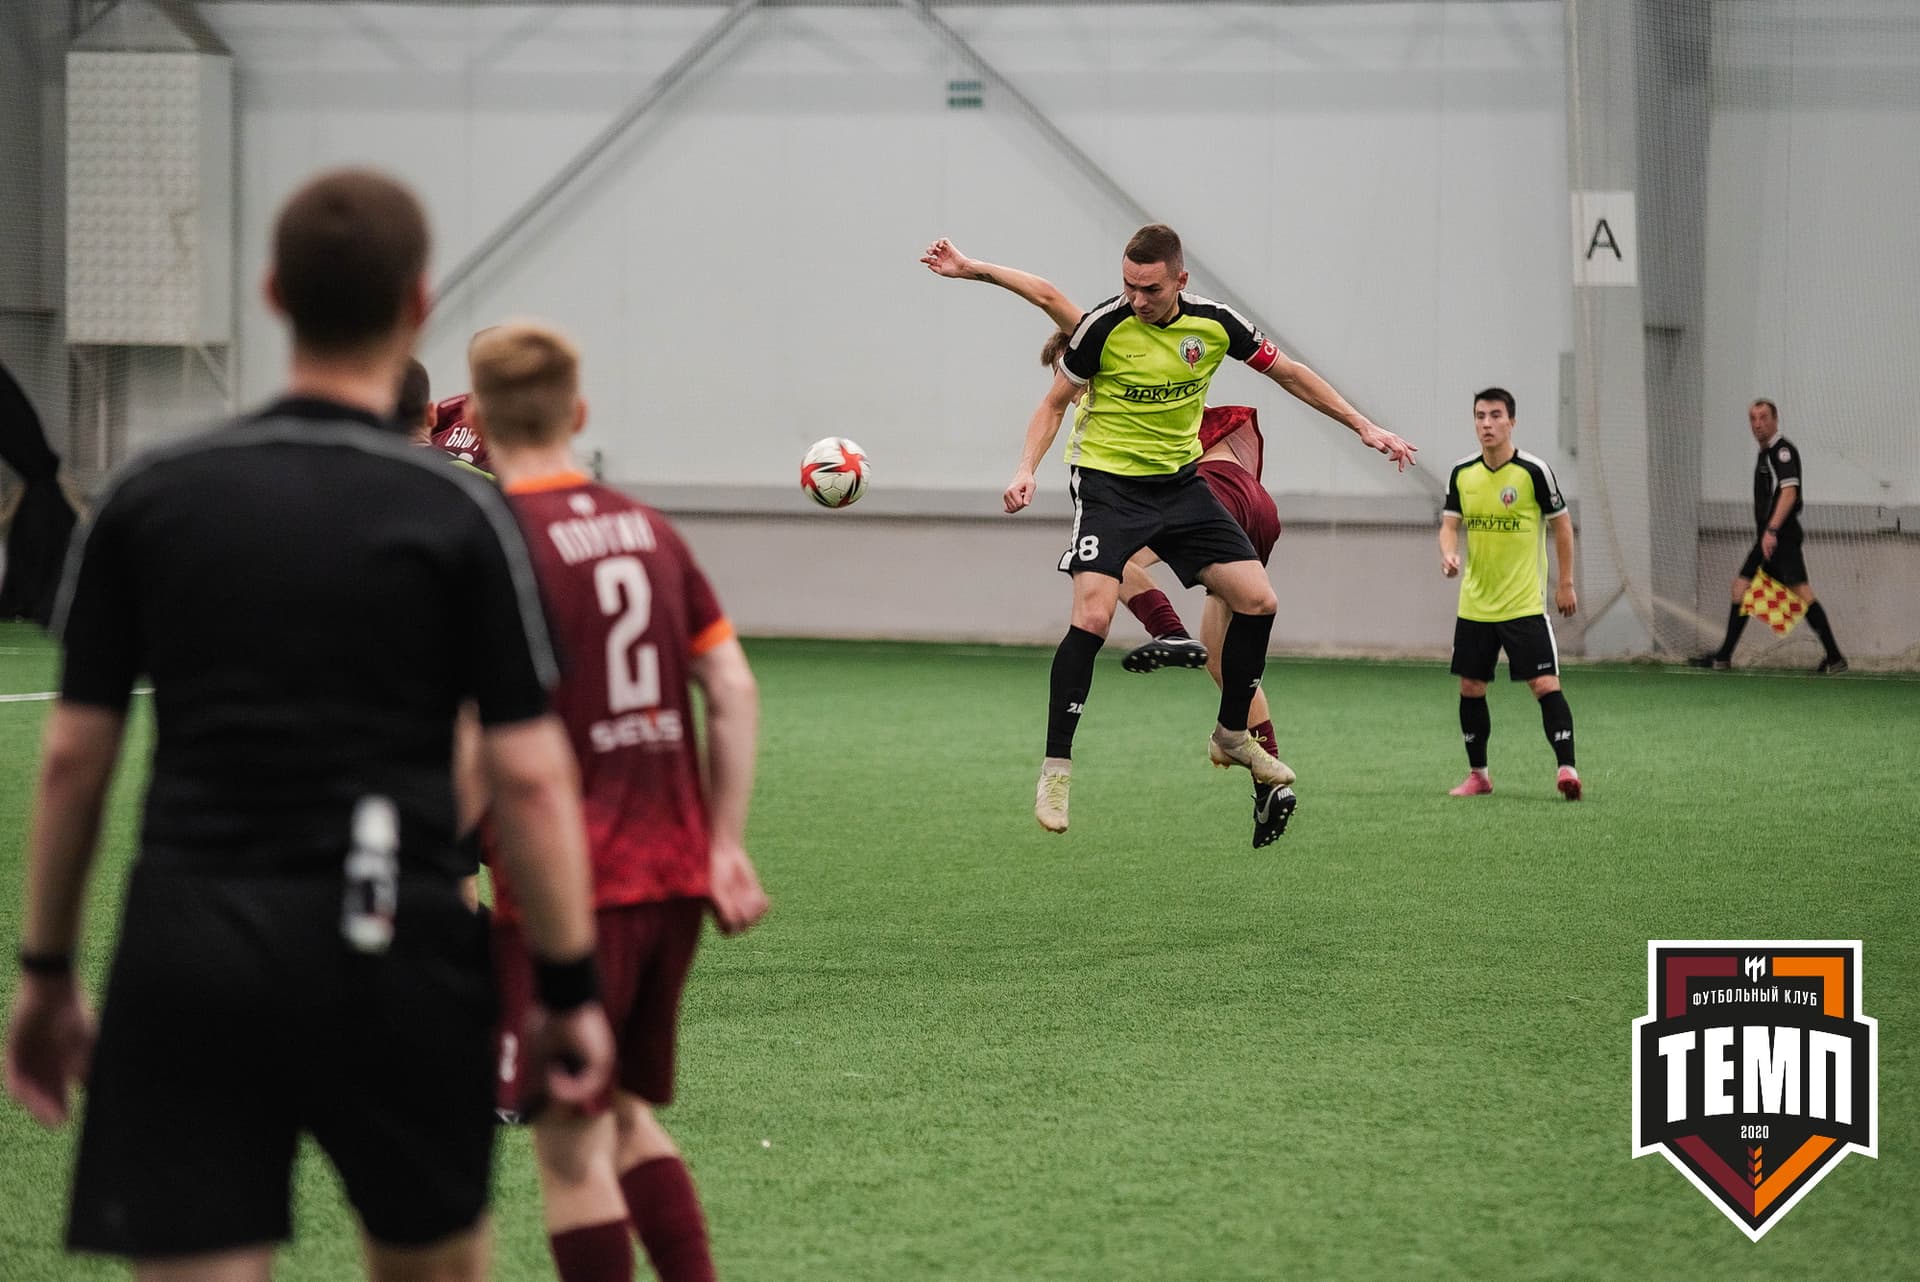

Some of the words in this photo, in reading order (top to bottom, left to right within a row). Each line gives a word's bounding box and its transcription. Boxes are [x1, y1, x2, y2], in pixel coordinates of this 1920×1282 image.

[1467, 517, 1521, 531] ИРКУТСК
[1078, 534, 1099, 562] 8
[594, 555, 661, 713] 2
